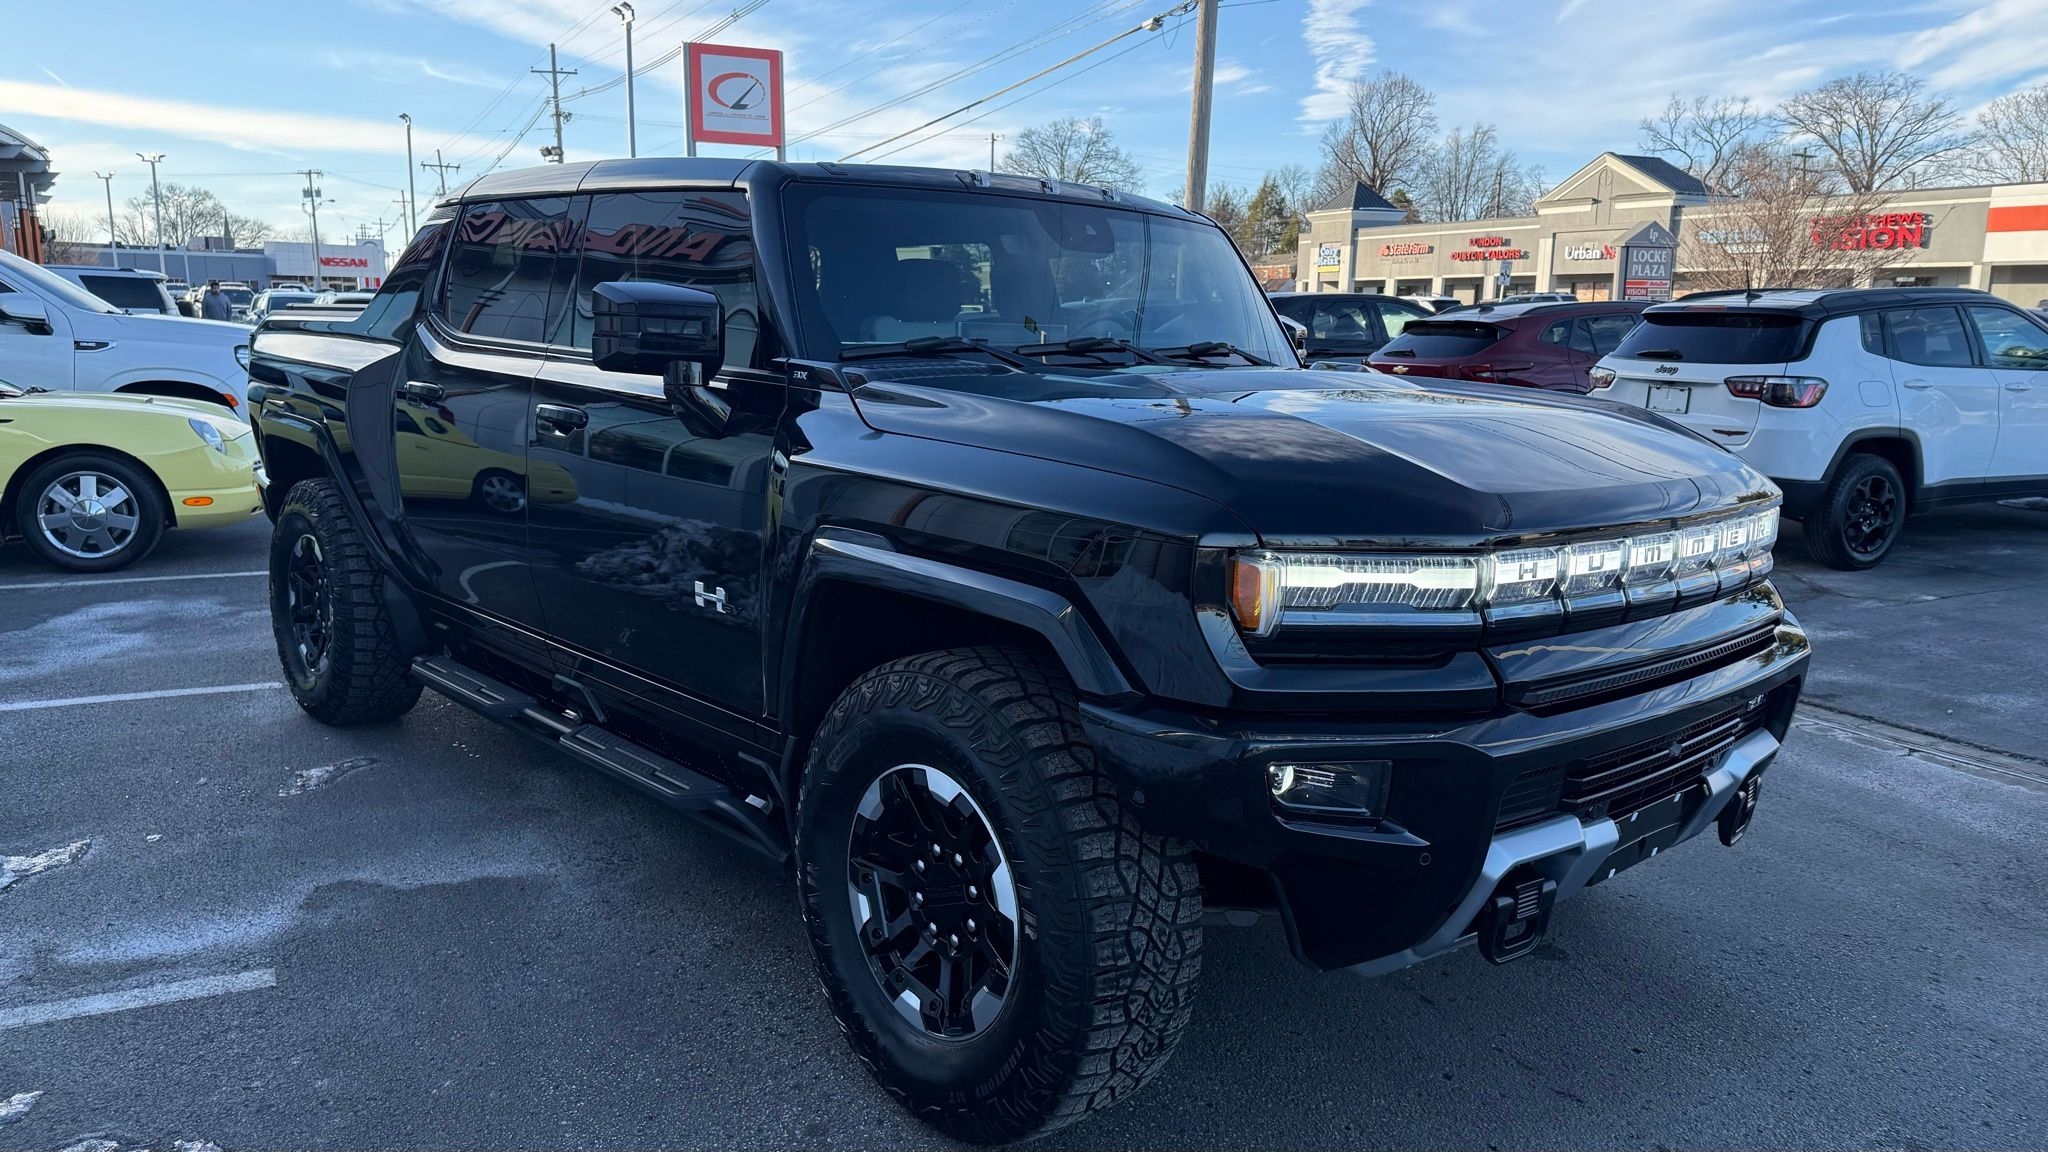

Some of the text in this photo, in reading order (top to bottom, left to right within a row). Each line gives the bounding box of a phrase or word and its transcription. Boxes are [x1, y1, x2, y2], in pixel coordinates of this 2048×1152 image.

[1469, 237, 1503, 247] LONDON
[1450, 249, 1521, 261] CUSTOM TAILORS
[1565, 246, 1600, 260] Urban
[1632, 250, 1668, 263] LOCKE
[320, 257, 368, 268] NISSAN
[1631, 264, 1666, 277] PLAZA
[1626, 288, 1647, 296] VISION
[1655, 364, 1679, 376] Jeep
